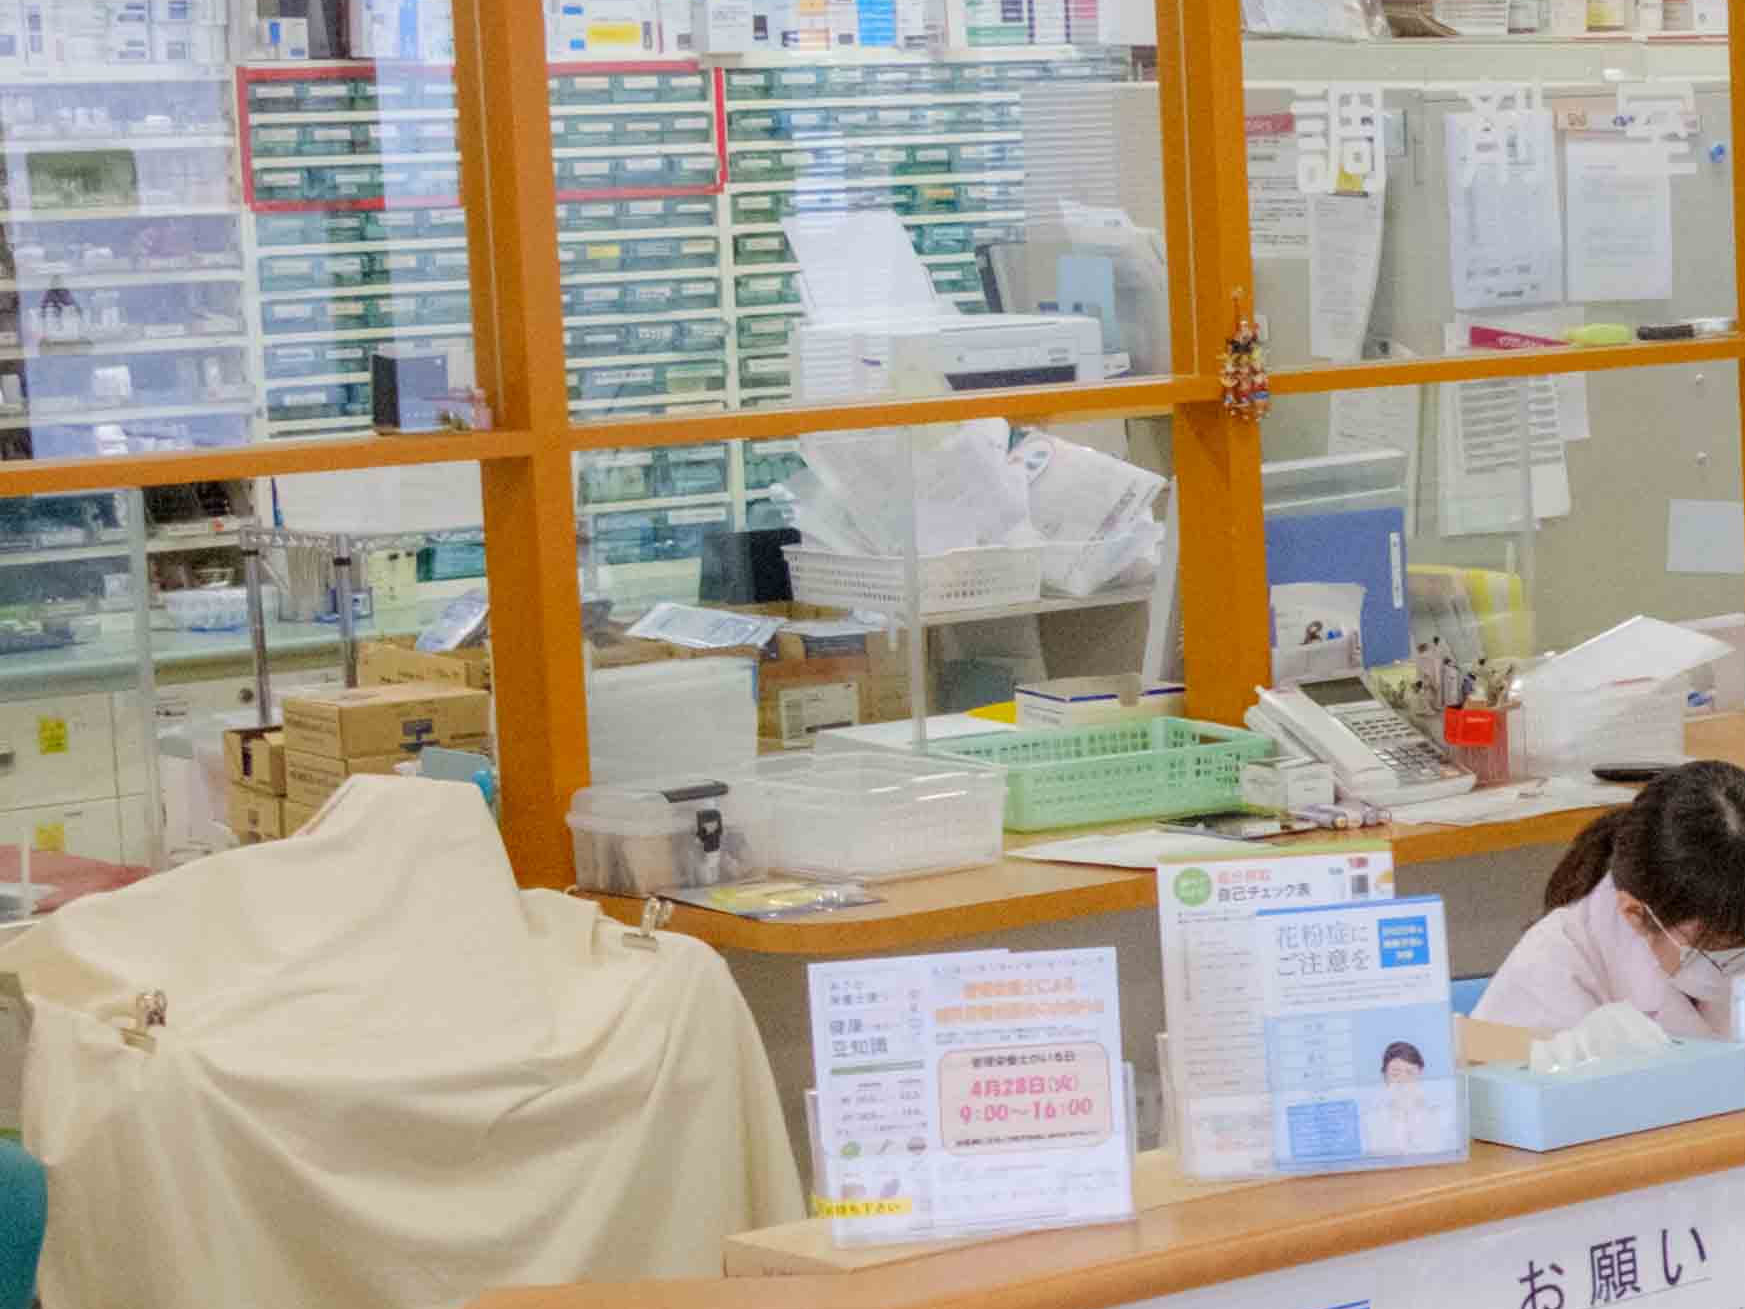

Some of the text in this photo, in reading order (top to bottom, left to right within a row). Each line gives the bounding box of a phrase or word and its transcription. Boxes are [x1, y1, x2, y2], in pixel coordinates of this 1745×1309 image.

[1276, 920, 1370, 949] 花粉症に
[1276, 948, 1372, 977] ご注意を
